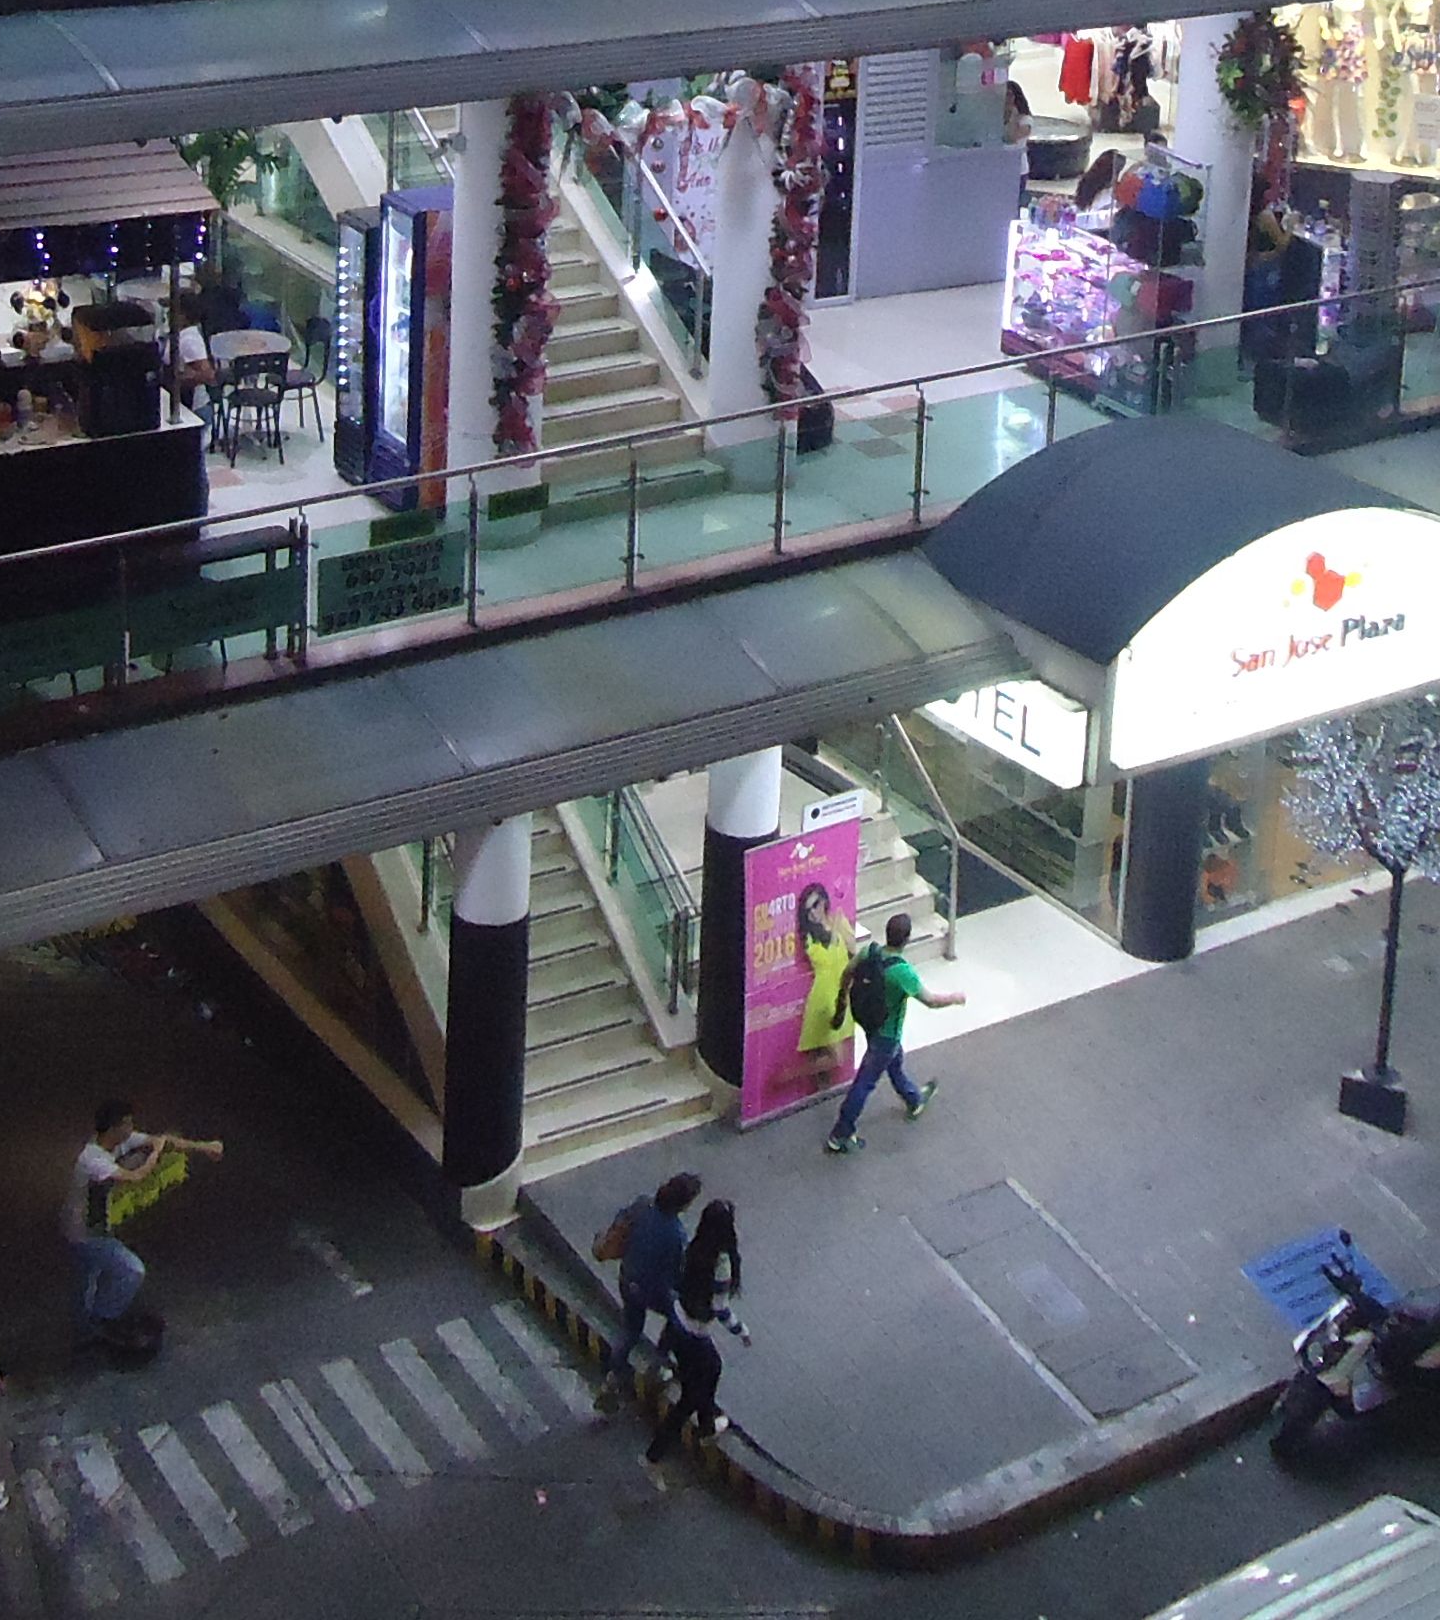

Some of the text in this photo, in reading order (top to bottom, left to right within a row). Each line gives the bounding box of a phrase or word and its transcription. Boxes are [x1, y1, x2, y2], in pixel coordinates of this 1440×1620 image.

[1230, 613, 1405, 677] San Jose Plaza
[754, 933, 796, 968] 2016
